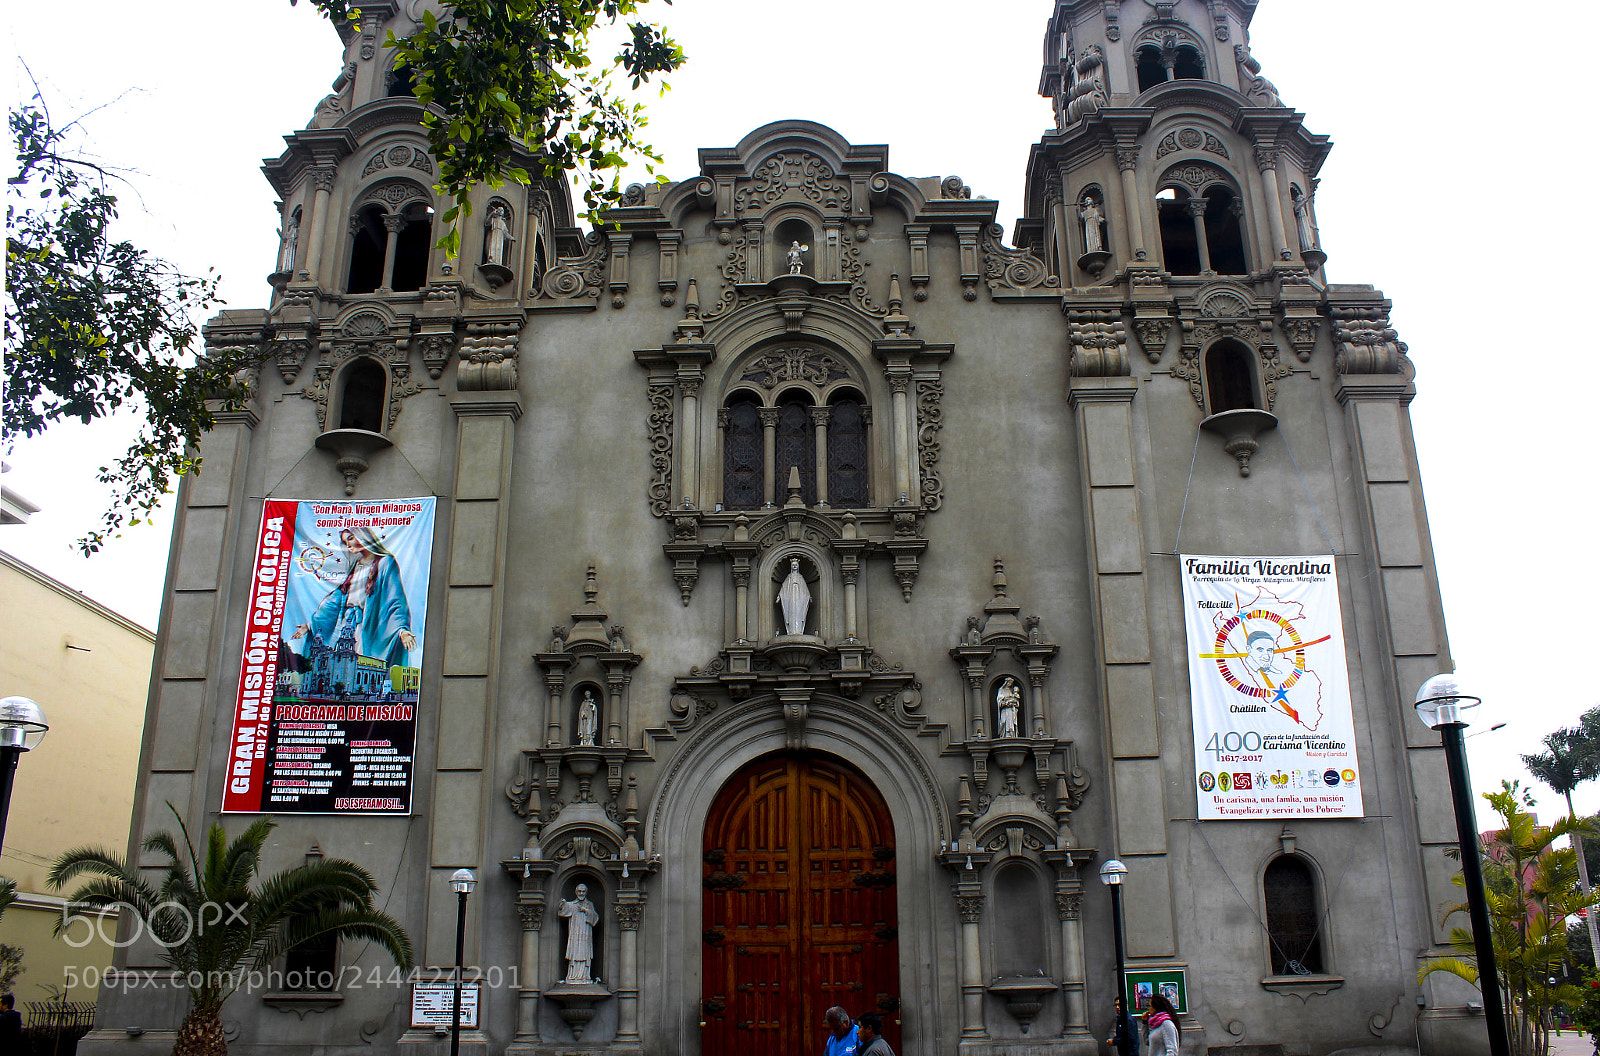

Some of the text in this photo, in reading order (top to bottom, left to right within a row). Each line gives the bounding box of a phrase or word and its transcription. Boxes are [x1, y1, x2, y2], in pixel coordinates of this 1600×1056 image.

[356, 504, 380, 514] Virgen
[316, 519, 342, 527] somos
[344, 518, 370, 528] Iglesia
[1186, 558, 1332, 576] Familia Vicentina
[1192, 576, 1224, 584] Parroquia
[1197, 600, 1234, 608] Folleville
[231, 516, 284, 794] GRAN MISIÓN CATÓLICA
[254, 550, 290, 758] Del 27 de Agosto al 24 de Septiembre
[275, 702, 413, 722] PROGRAMA DE MISIÓN
[1204, 731, 1262, 762] 400
[1263, 740, 1346, 750] Carisma Vicentino
[335, 798, 349, 808] LOS
[1214, 796, 1224, 804] Un
[1226, 796, 1258, 804] carisma,
